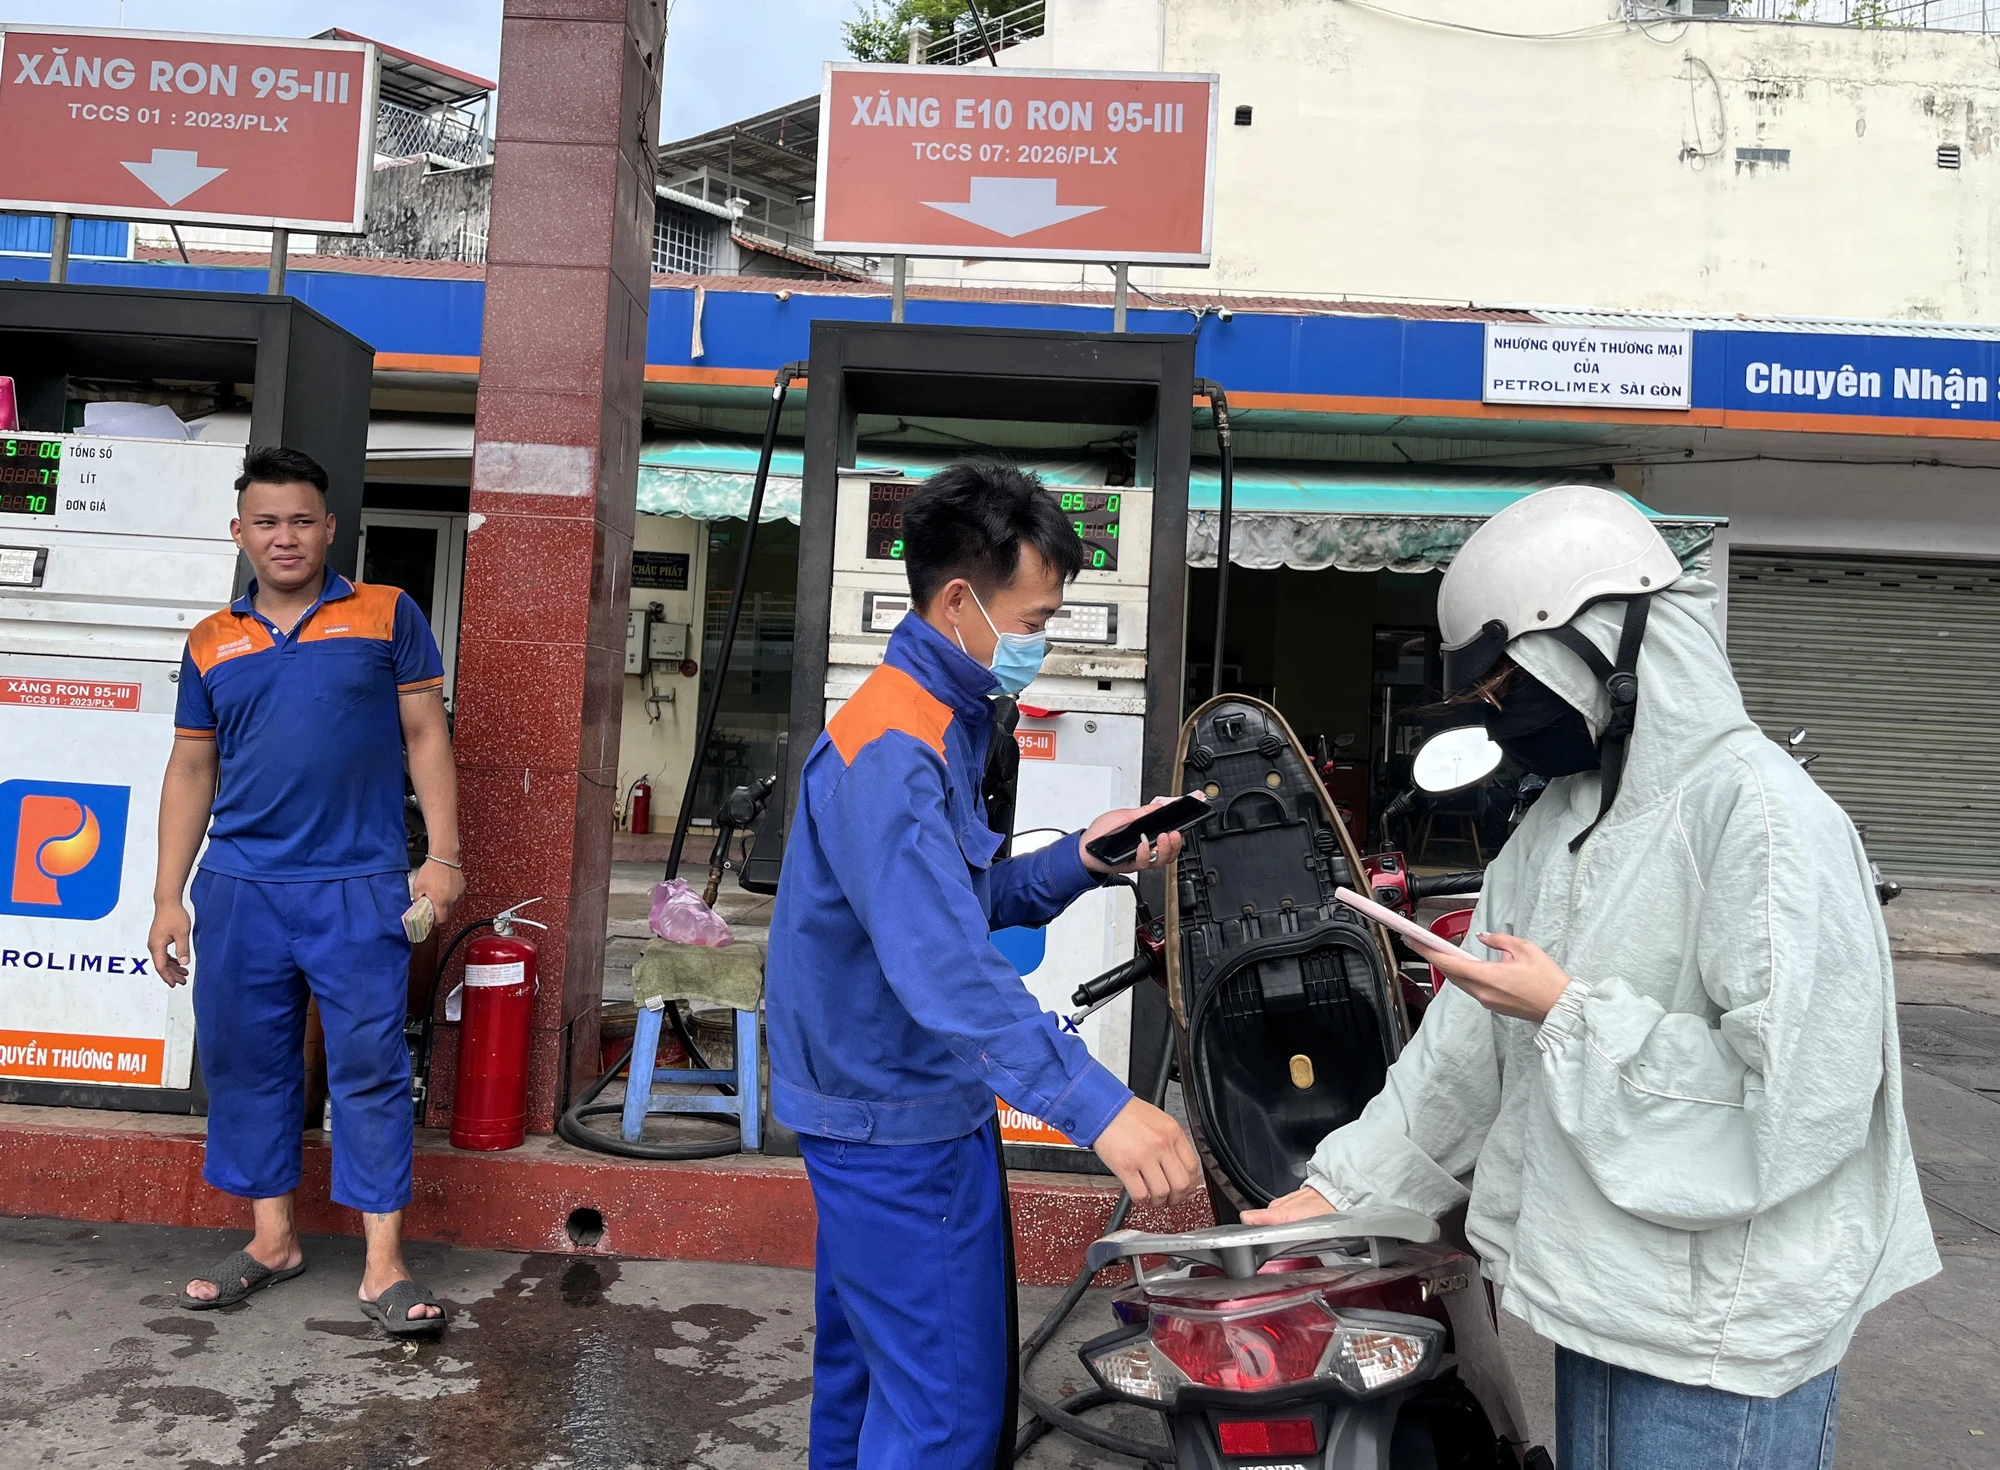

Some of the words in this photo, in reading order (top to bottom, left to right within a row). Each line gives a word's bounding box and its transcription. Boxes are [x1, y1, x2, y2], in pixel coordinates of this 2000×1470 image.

[13, 47, 136, 90] XĂNG
[150, 60, 238, 97] RON
[251, 67, 349, 104] 95-III
[68, 103, 130, 122] TCCS
[137, 108, 160, 124] 01
[184, 111, 289, 133] 2023/PLX
[850, 89, 940, 128] XĂNG
[955, 98, 1012, 130] E10
[1027, 101, 1093, 131] RON
[1107, 102, 1184, 133] 95-III
[912, 142, 972, 162] TCCS
[979, 144, 1010, 162] 07:
[1018, 145, 1118, 165] 2026/PLX
[1494, 337, 1548, 352] NHƯỢNG
[1552, 337, 1596, 353] QUYỀN
[1600, 341, 1653, 354] THƯƠNG
[1657, 344, 1683, 357] MẠI
[1573, 358, 1600, 373] CỦA
[1493, 379, 1611, 394] PETROLIMEX
[1620, 382, 1645, 395] SÀI
[1650, 383, 1682, 397] GÒN
[1745, 361, 1881, 400] Chuyên
[1893, 367, 1988, 410] Nhận
[70, 442, 96, 458] TỔNG
[99, 444, 113, 459] SỐ
[80, 471, 97, 484] LÍT
[66, 499, 86, 511] ĐƠN
[90, 498, 106, 511] GIÁ
[659, 565, 684, 577] PHÁT
[7, 680, 52, 695] XĂNG
[56, 684, 90, 696] RON
[94, 687, 130, 699] 95-III
[20, 694, 47, 704] TCCS
[49, 697, 61, 705] 01
[69, 698, 115, 708] 2023/PLX
[1018, 736, 1048, 749] 95-III
[1, 949, 150, 975] ROLIMEX
[52, 1047, 113, 1071] THƯƠNG
[117, 1052, 148, 1075] MẠI
